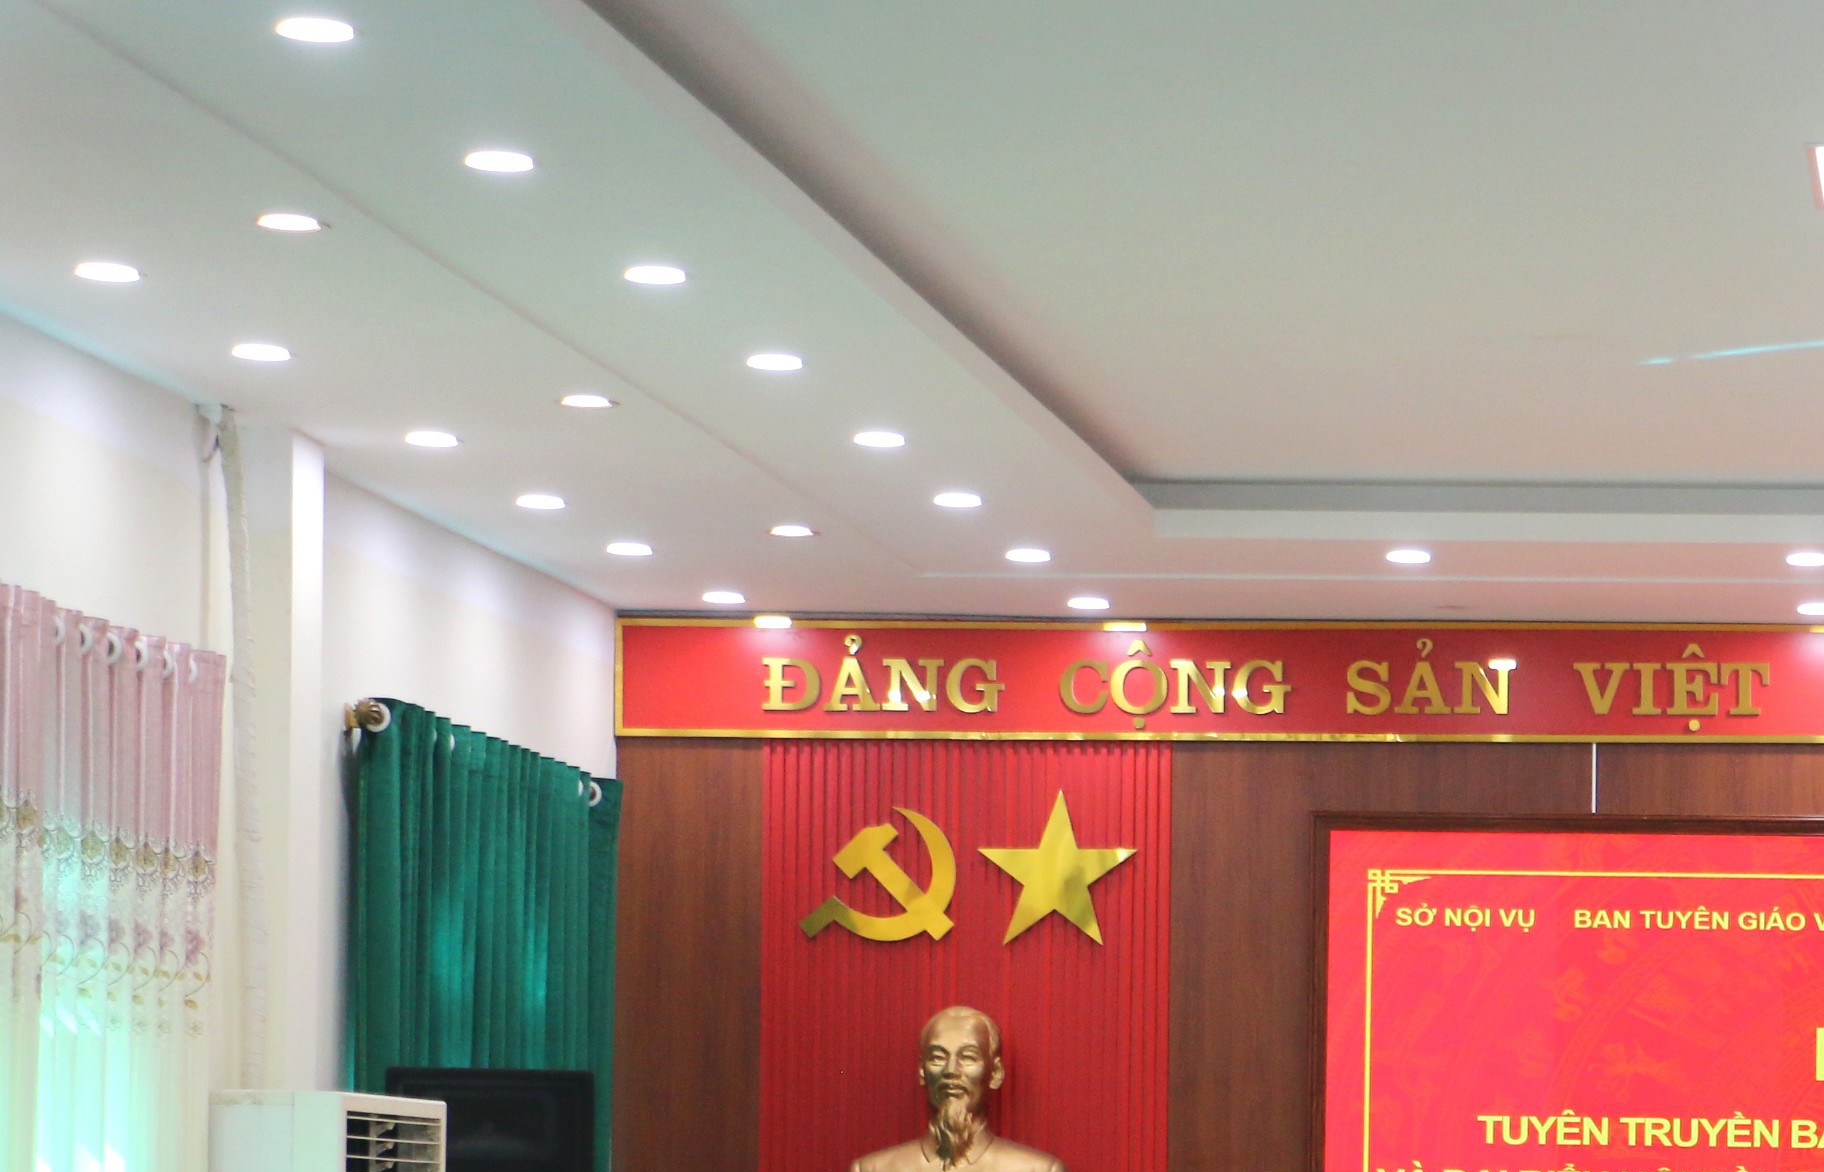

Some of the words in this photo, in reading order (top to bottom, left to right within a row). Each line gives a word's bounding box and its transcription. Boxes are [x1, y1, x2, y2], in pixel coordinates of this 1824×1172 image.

[761, 634, 1004, 712] ĐẢNG
[1059, 638, 1292, 729] CỘNG
[1346, 638, 1517, 715] SẢN
[1574, 643, 1769, 731] VIỆT
[1395, 902, 1438, 927] SỞ
[1444, 905, 1491, 932] NỘI
[1498, 908, 1536, 933] VỤ
[1574, 909, 1631, 929] BAN
[1639, 905, 1730, 931] TUYÊN
[1737, 906, 1806, 931] GIÁO
[1476, 1108, 1609, 1146] TUYÊN
[1619, 1111, 1780, 1148] TRUYỀN
